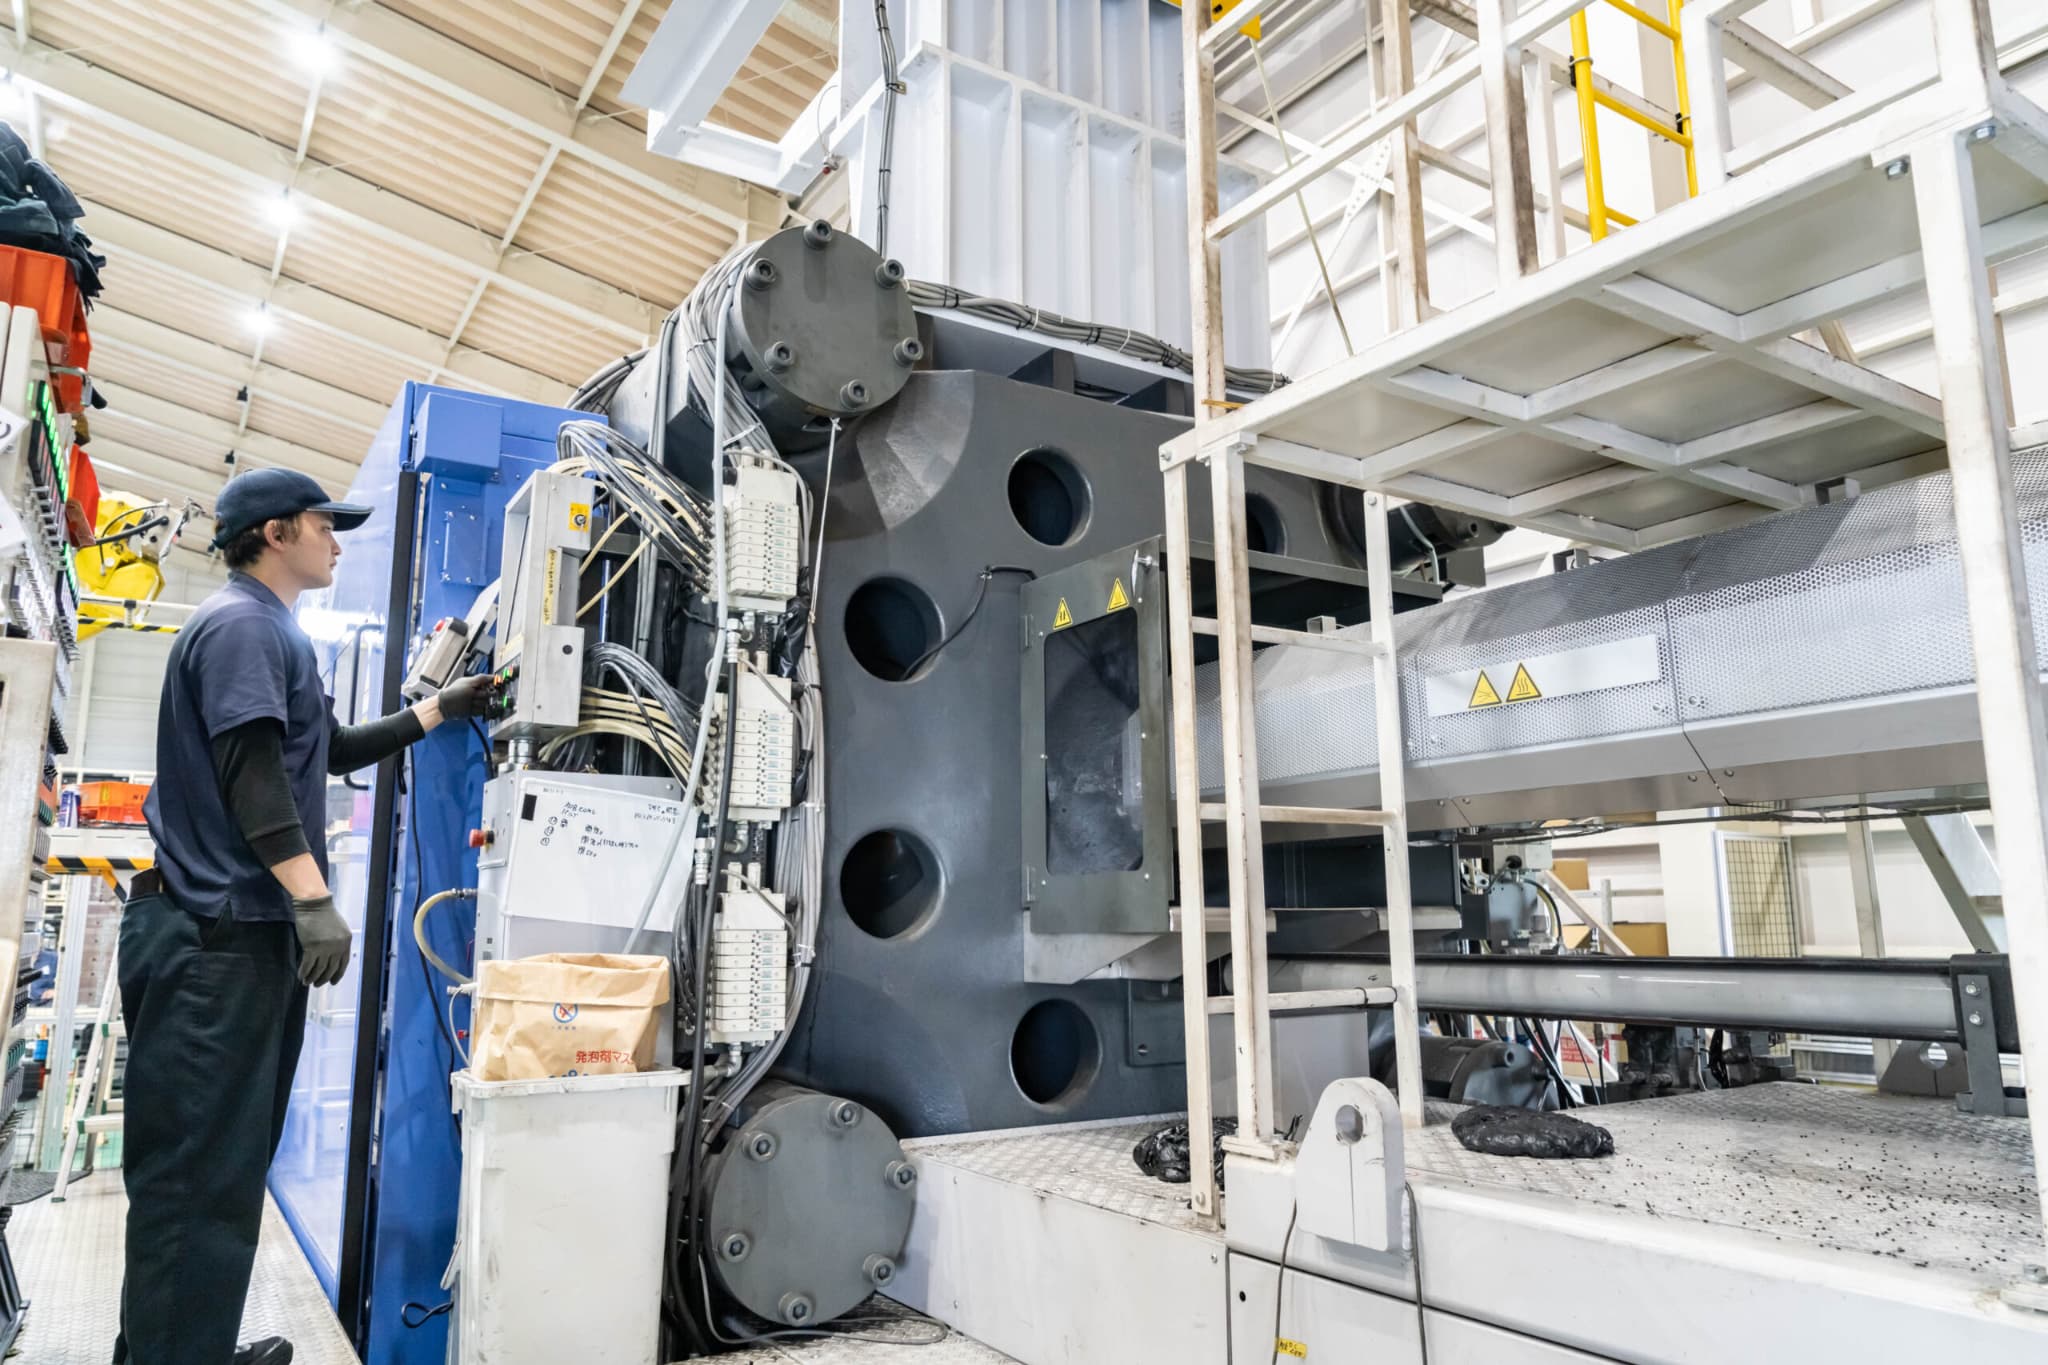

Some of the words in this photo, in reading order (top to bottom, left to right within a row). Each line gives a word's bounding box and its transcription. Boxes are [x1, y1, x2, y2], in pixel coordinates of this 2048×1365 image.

[575, 1049, 634, 1066] 発泡剤マス
